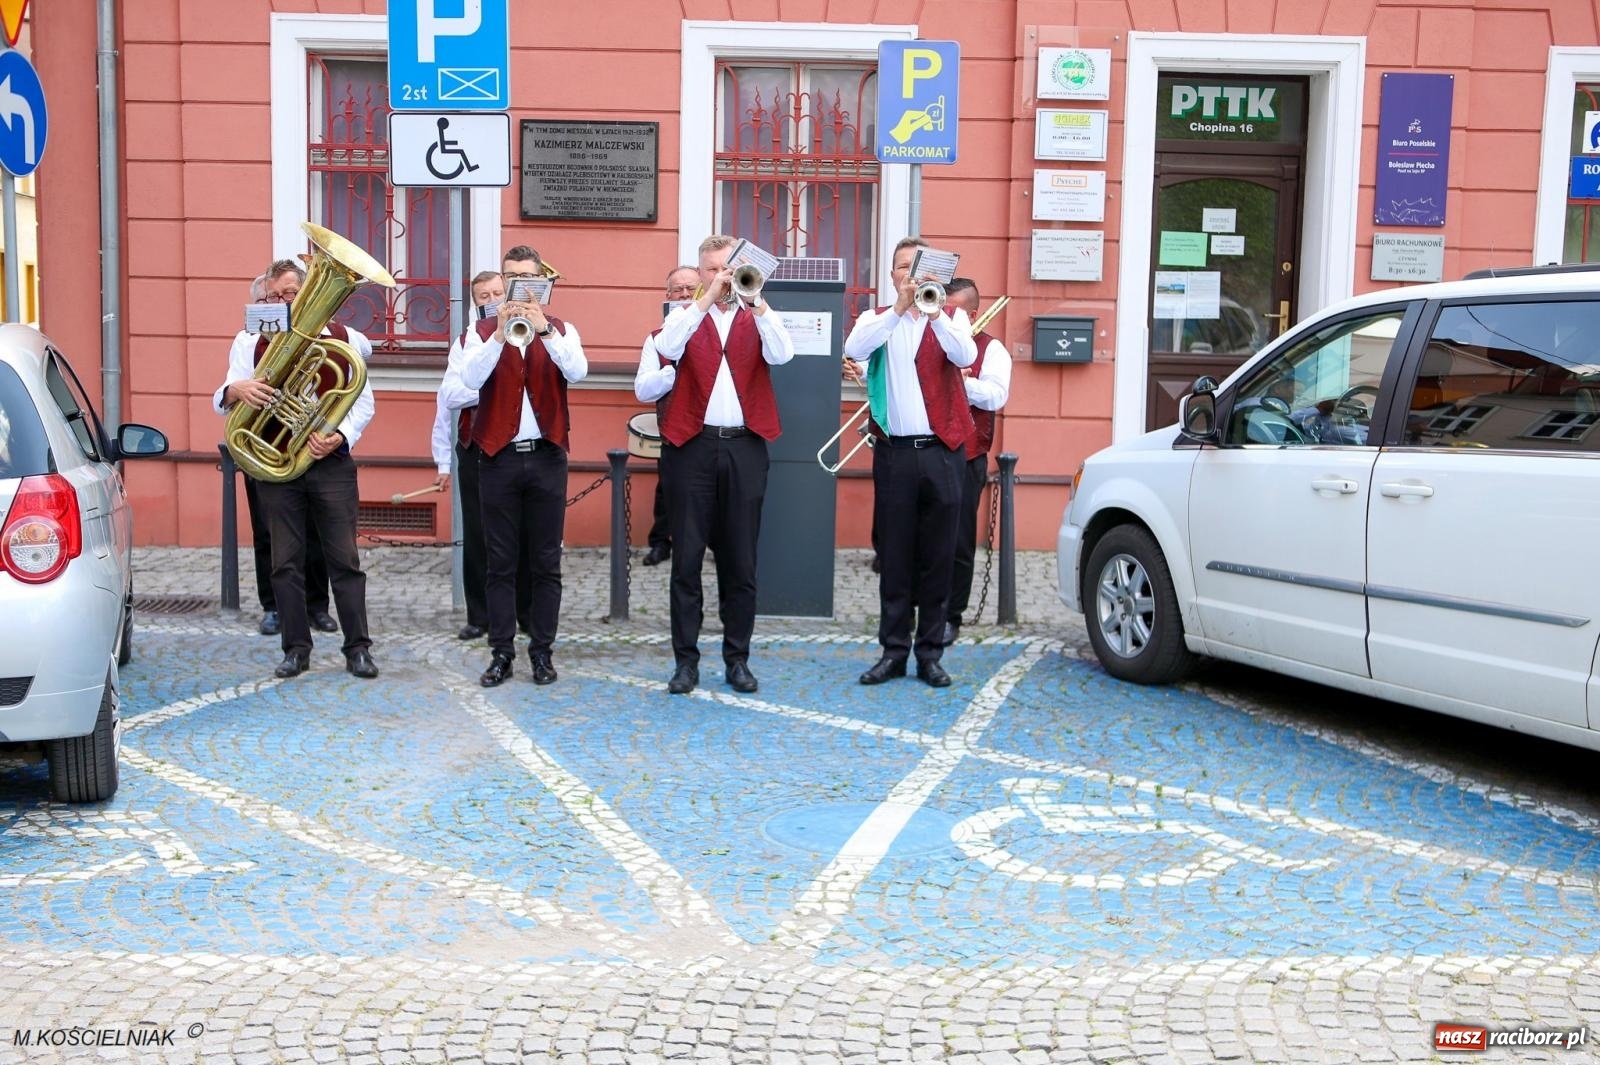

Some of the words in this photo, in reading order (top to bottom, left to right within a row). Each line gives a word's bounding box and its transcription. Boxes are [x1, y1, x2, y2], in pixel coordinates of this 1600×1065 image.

[417, 0, 482, 62] P
[902, 49, 943, 98] P
[402, 84, 428, 101] 2st
[1171, 85, 1277, 119] PTTK
[1190, 122, 1236, 134] Chopina
[1240, 124, 1254, 133] 16
[534, 140, 582, 149] KAZIMIERZ
[586, 141, 644, 150] MALCZEWSKI
[884, 146, 950, 158] PARKOMAT
